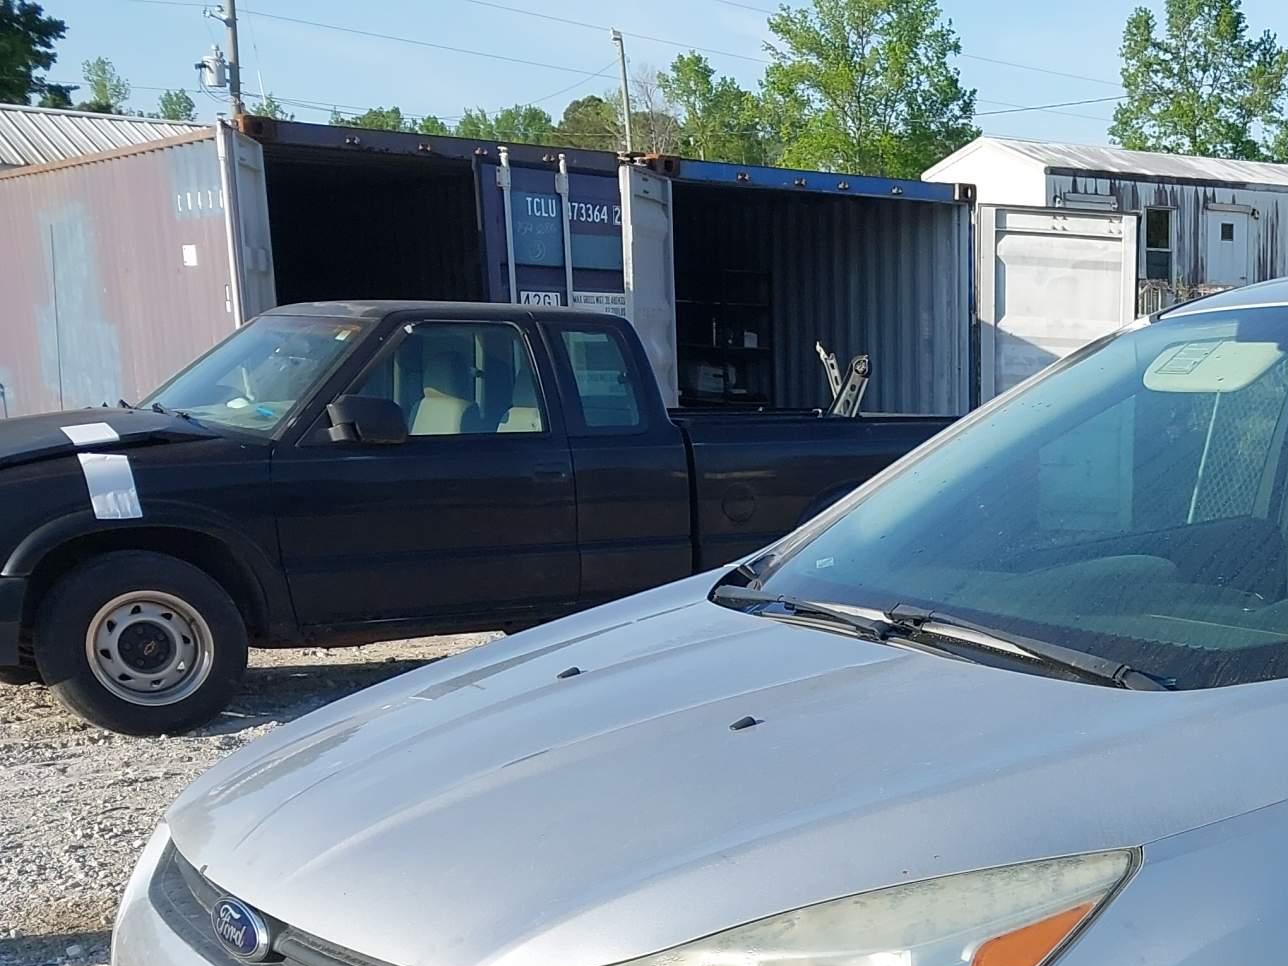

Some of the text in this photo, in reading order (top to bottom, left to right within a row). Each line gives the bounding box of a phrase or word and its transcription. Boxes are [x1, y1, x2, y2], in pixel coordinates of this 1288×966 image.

[526, 197, 556, 217] TCLU
[524, 293, 559, 306] 42G1
[216, 904, 247, 948] Ford
